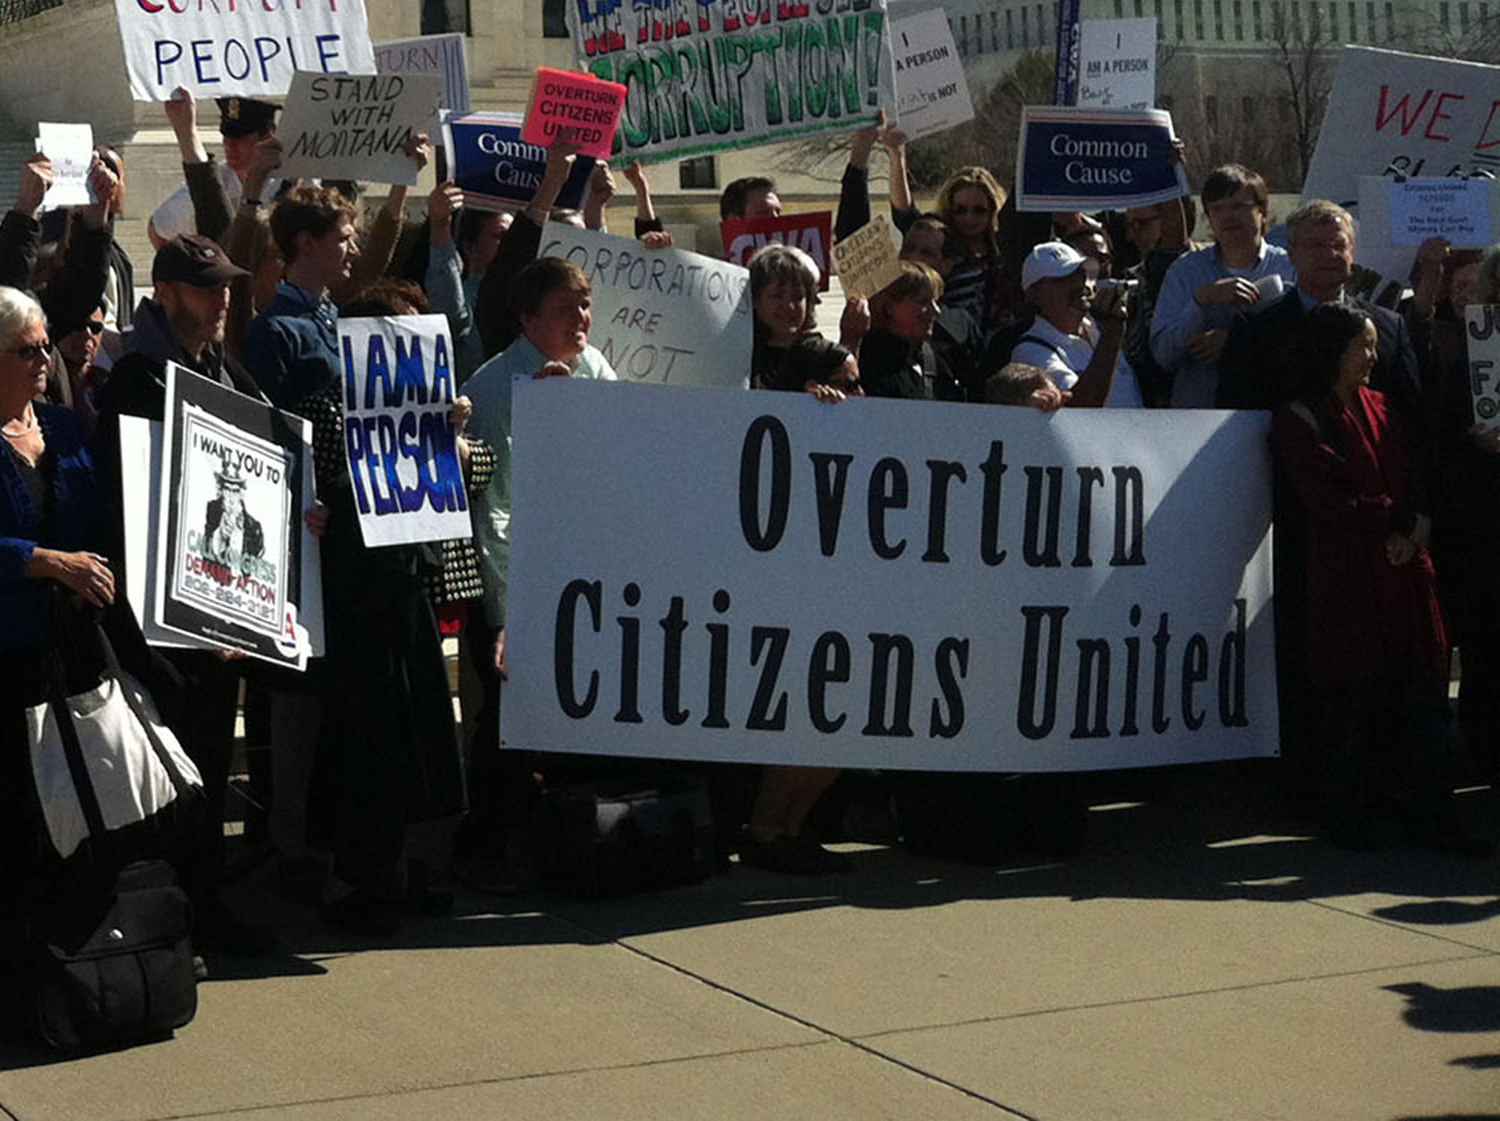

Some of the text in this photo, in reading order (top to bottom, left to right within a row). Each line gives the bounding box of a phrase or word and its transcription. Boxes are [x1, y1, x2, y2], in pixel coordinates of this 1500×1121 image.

[153, 34, 349, 86] PEOPLE
[905, 45, 950, 69] PERSON
[1087, 58, 1149, 74] AM A PERSON
[311, 77, 405, 103] STAND
[544, 83, 618, 105] OVERTURN
[937, 82, 957, 100] NOT
[331, 106, 394, 127] WITH
[540, 100, 615, 125] CITIZENS
[1375, 84, 1465, 142] WE
[288, 128, 416, 159] MONTANA
[477, 133, 547, 161] Comm
[1050, 134, 1148, 159] Common
[495, 160, 542, 188] Caus
[1065, 161, 1132, 185] Cause
[611, 307, 663, 333] ARE
[342, 334, 453, 411] I AM A
[600, 337, 695, 382] NOT
[193, 433, 280, 485] I WANT YOU TO
[346, 411, 467, 515] PERSON
[738, 414, 1146, 568] Overturn
[554, 579, 1249, 740] Citizens United
